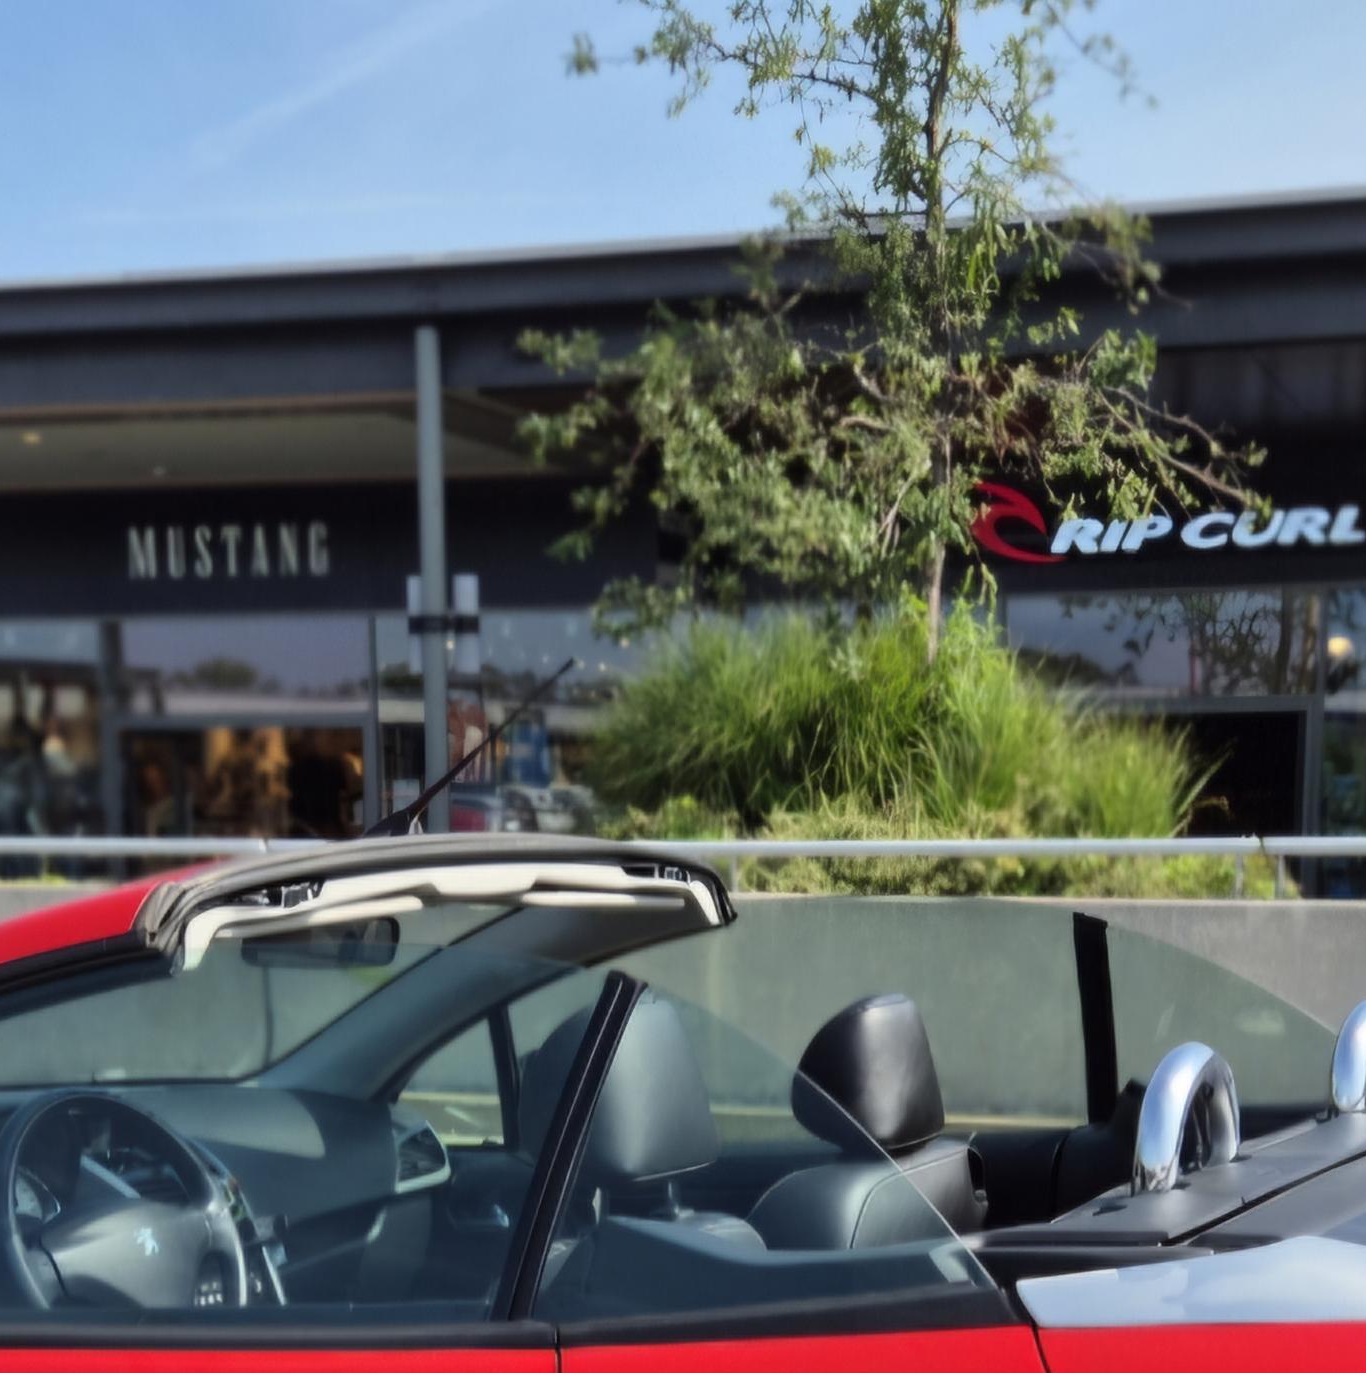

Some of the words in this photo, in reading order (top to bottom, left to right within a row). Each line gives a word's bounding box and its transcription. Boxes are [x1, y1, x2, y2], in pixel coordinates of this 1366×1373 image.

[128, 519, 331, 580] MUSTANG
[1051, 514, 1174, 554] RIP
[1180, 504, 1366, 549] CURL
